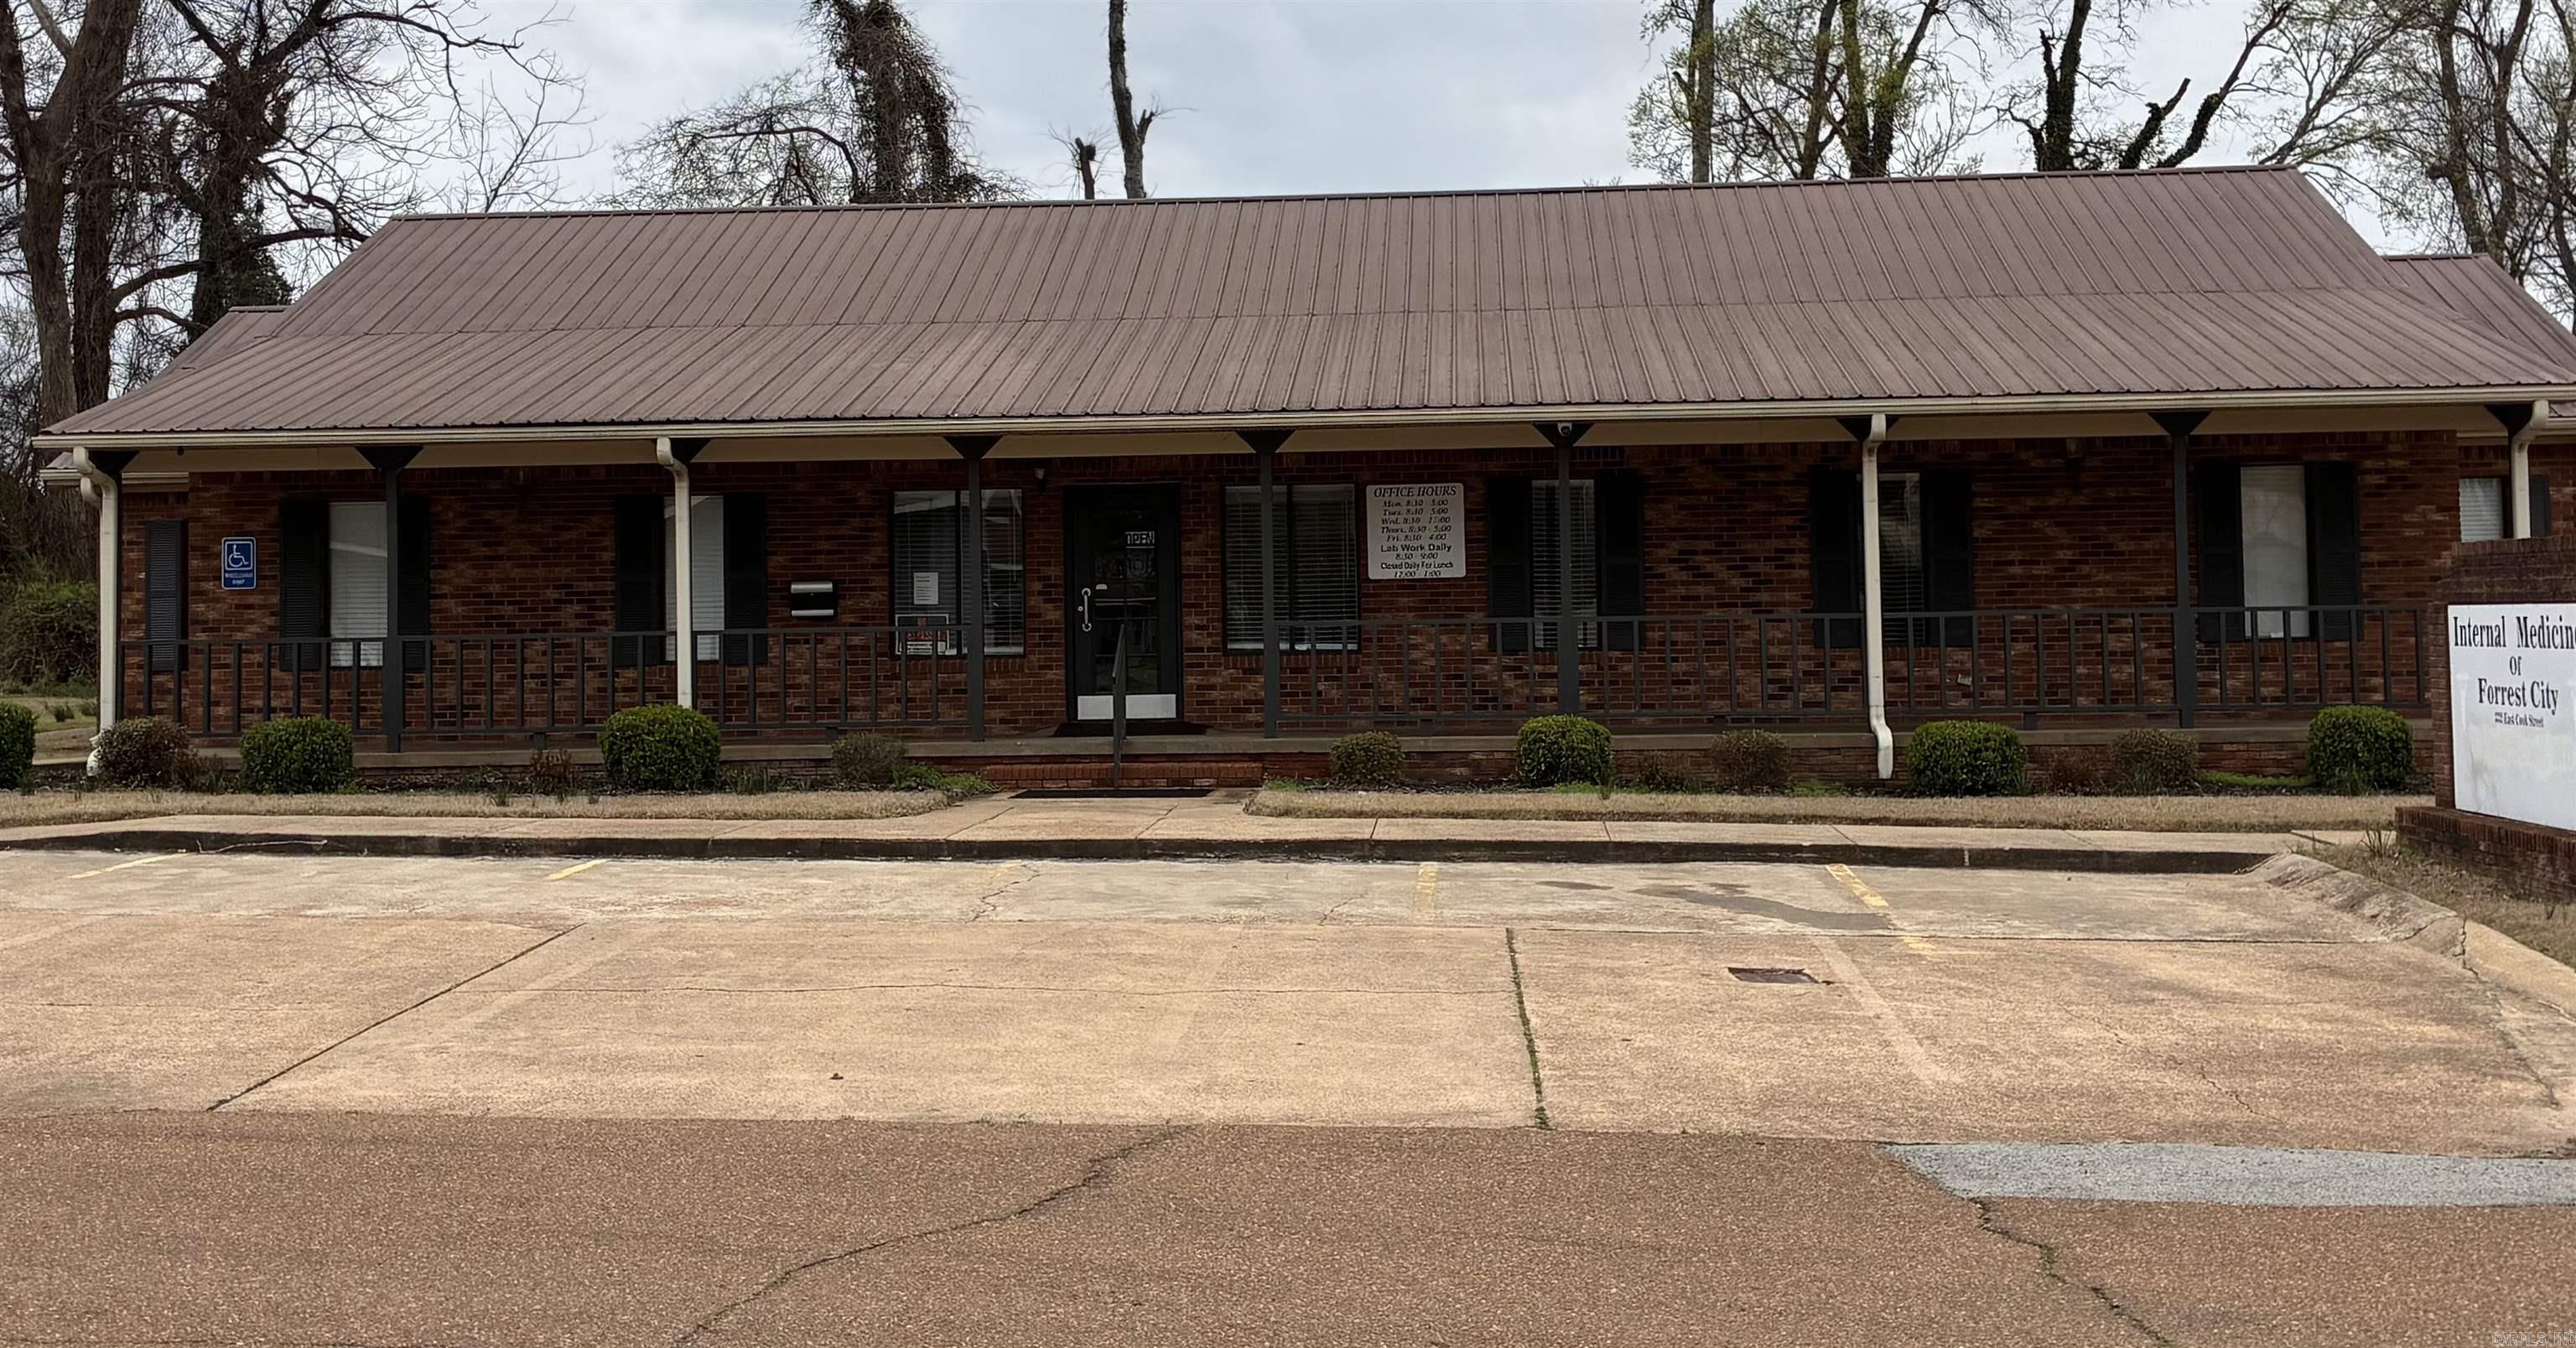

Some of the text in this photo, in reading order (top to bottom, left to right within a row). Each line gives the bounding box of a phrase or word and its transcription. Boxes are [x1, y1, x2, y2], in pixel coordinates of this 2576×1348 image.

[1374, 485, 1457, 497] OFFICE HOURS
[1428, 543, 1452, 552] Daily
[1404, 562, 1420, 571] Daily
[1433, 561, 1453, 569] Lunch
[2454, 615, 2576, 650] Internal Medicin
[2478, 677, 2559, 715] Forrest City
